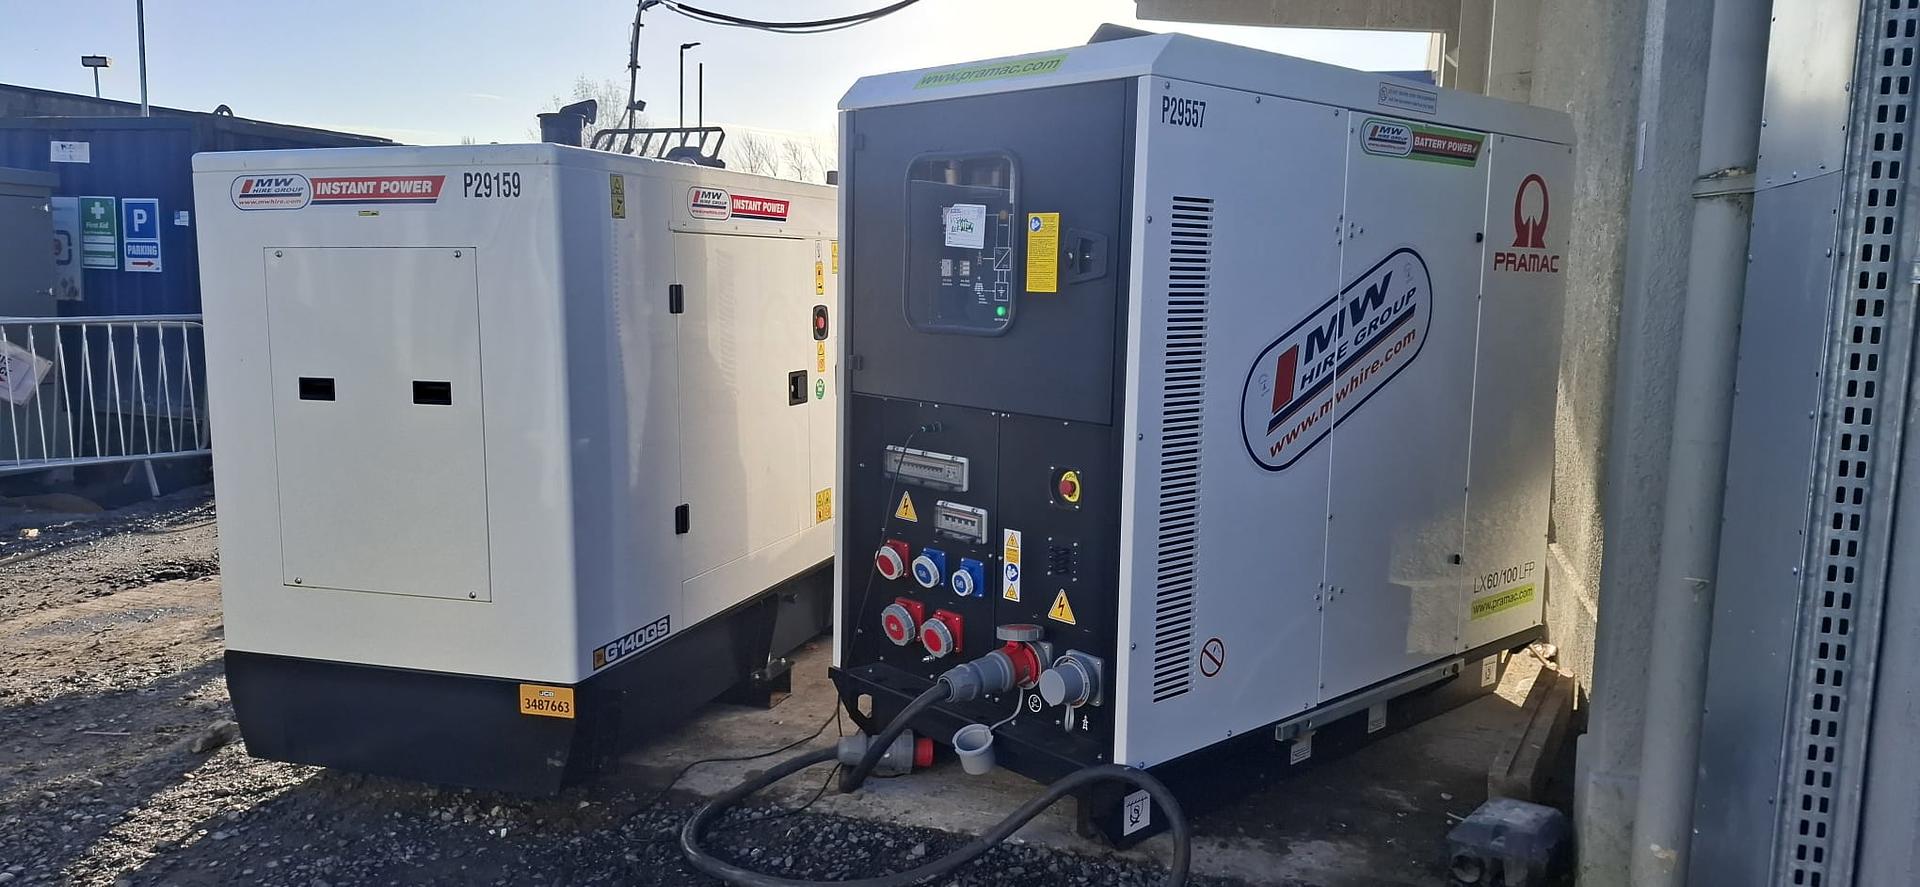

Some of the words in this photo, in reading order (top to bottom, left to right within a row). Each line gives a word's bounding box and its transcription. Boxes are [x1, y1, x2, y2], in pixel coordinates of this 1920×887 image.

[921, 57, 1061, 85] www.pramac.com
[1162, 95, 1207, 128] P29557
[1380, 126, 1404, 135] MW
[1414, 136, 1447, 149] BATTERY
[1447, 142, 1473, 153] POWER
[255, 178, 294, 187] MW
[316, 181, 376, 195] INSTANT
[379, 180, 433, 194] POWER
[463, 172, 521, 198] P29159
[701, 191, 722, 200] MW
[733, 199, 762, 211] INSTANT
[762, 202, 785, 213] POWER
[132, 208, 147, 232] P
[127, 245, 158, 256] PARKING
[1493, 252, 1560, 273] PRAMAC
[1304, 270, 1393, 366] MW
[1300, 341, 1349, 390] HIRE
[1354, 286, 1417, 346] GROUP
[1269, 329, 1416, 458] www.mwhire.com
[1519, 561, 1535, 580] LFP
[1473, 588, 1533, 614] www.pramac.com
[605, 618, 668, 662] G140QS
[524, 698, 570, 713] 3487663
